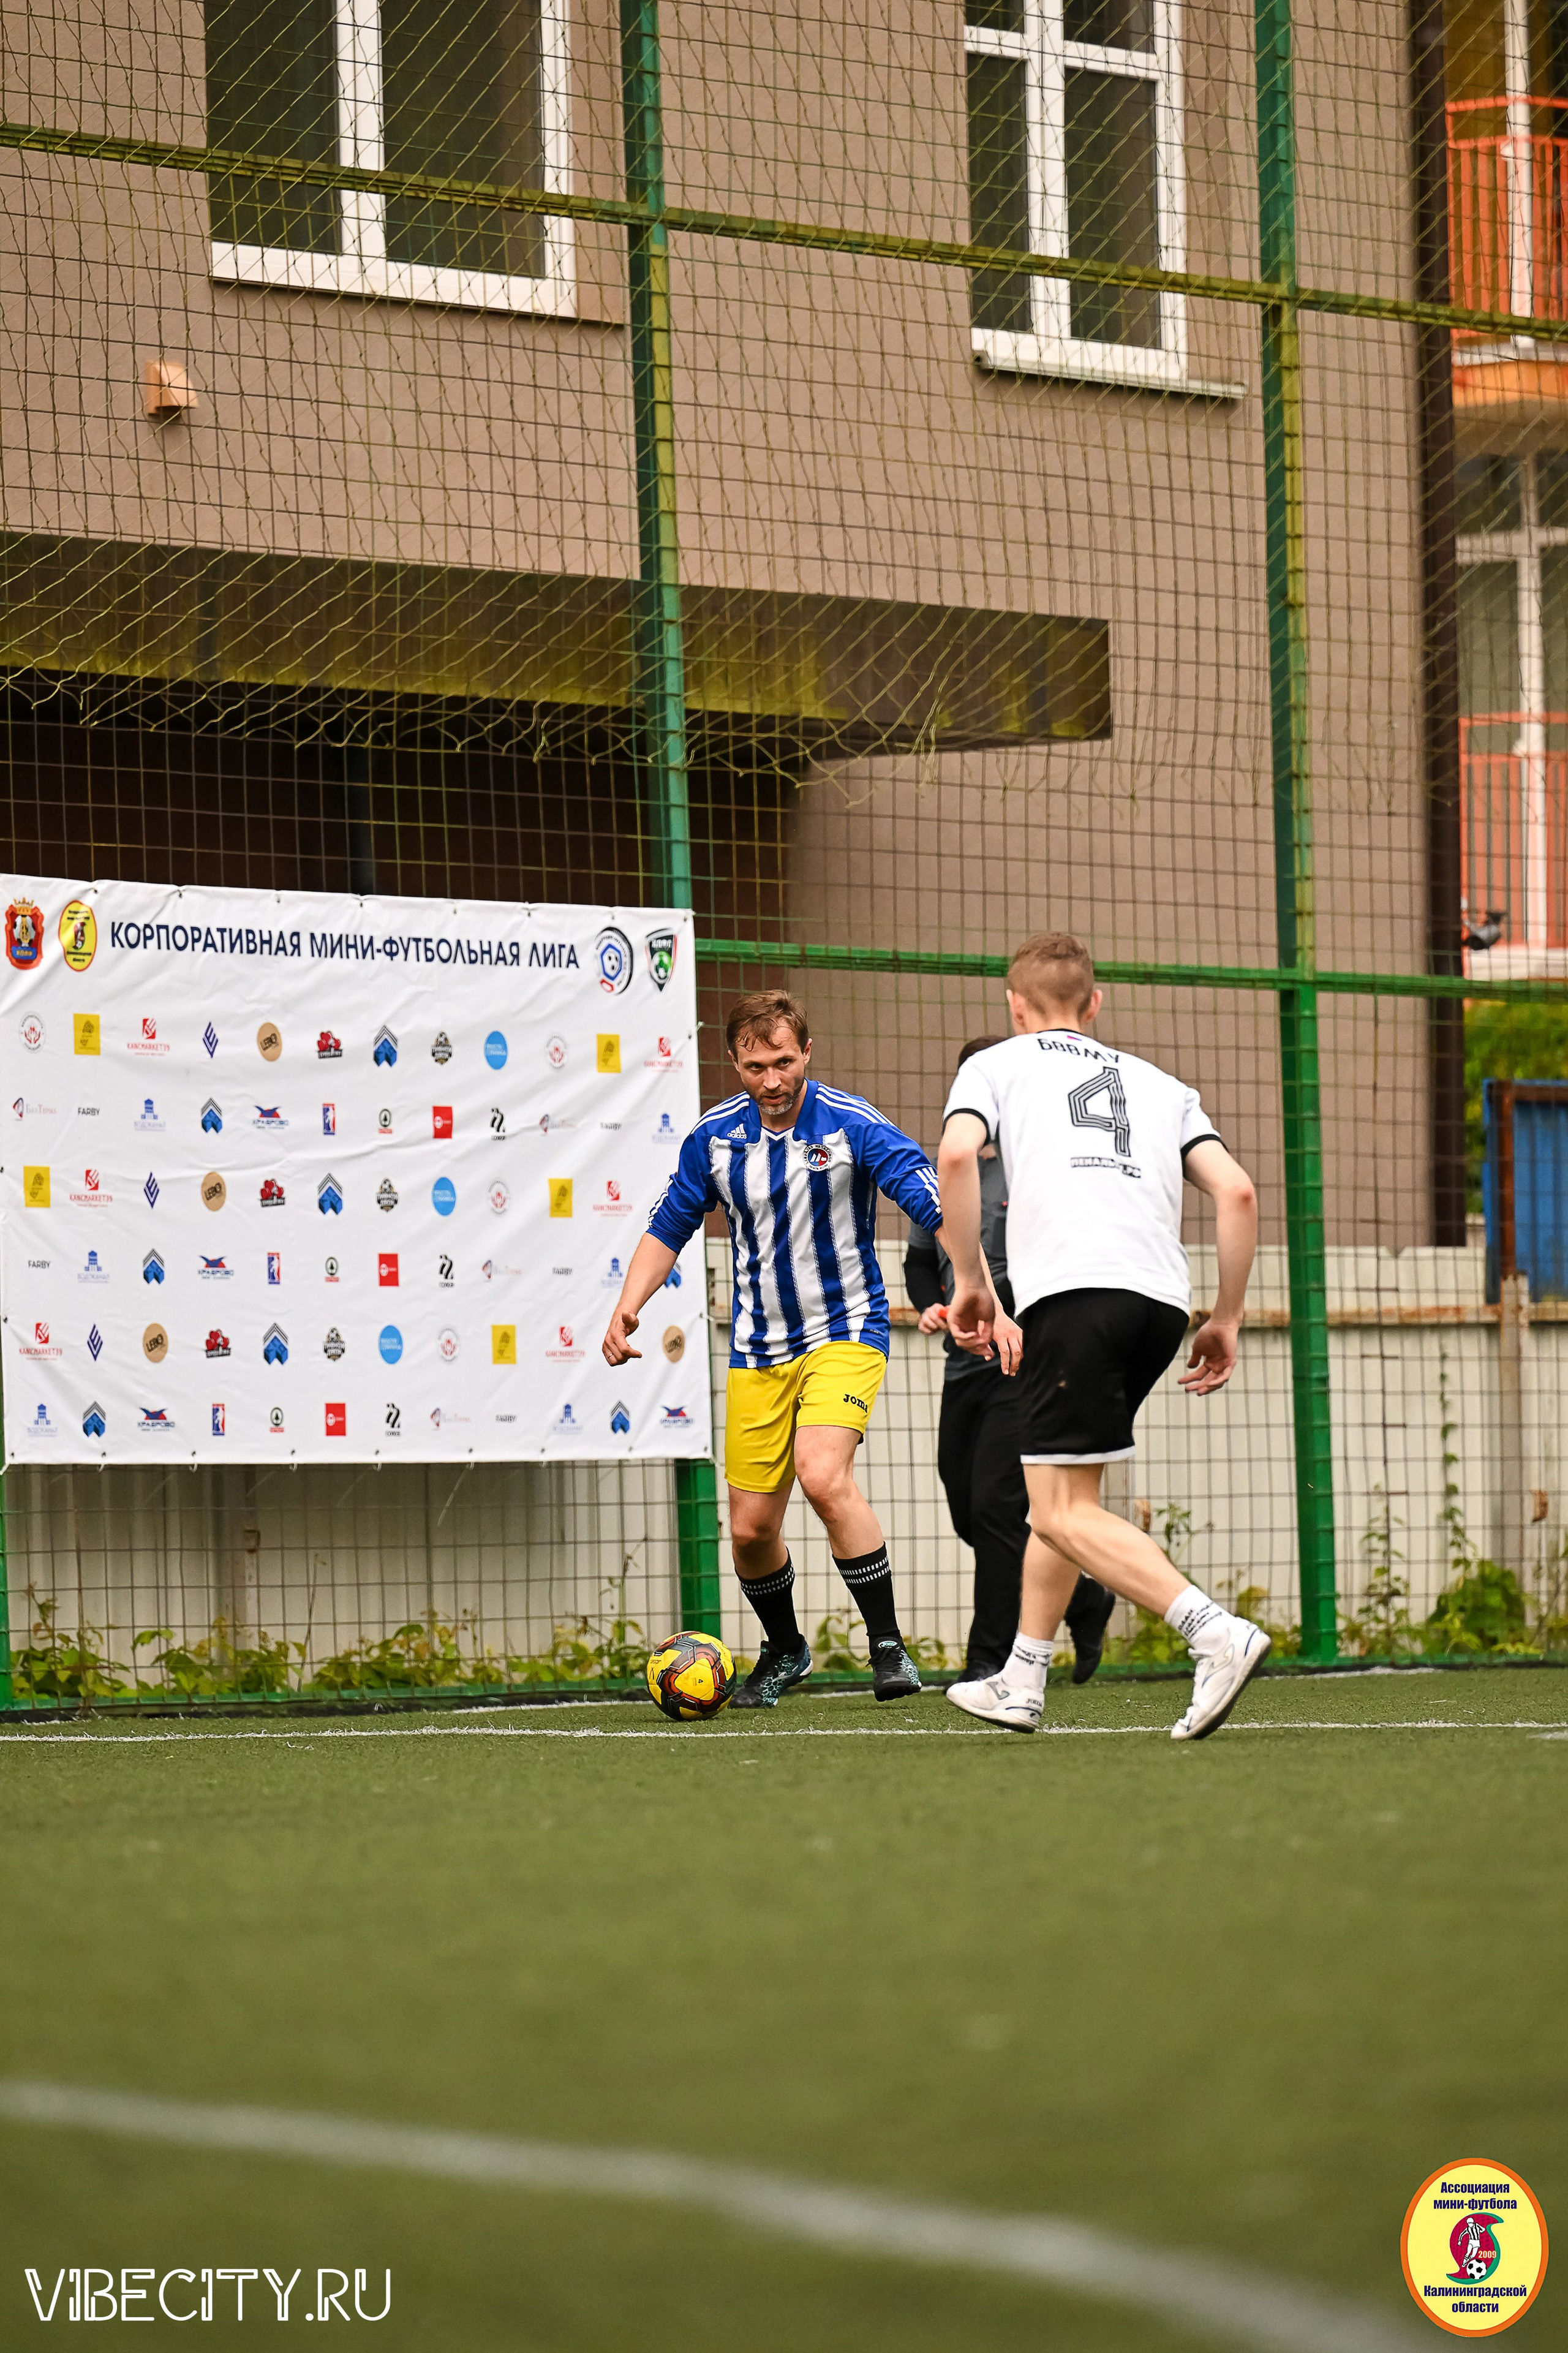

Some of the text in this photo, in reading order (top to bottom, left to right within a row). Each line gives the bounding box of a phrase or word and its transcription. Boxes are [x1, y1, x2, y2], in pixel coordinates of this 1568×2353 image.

[111, 921, 301, 957] КОРПОРАТИВНАЯ
[310, 932, 520, 967] МИНИ-ФУТБОЛЬНАЯ
[529, 942, 580, 969] ЛИГА
[1068, 1067, 1131, 1157] 4
[28, 1260, 51, 1269] FARBY
